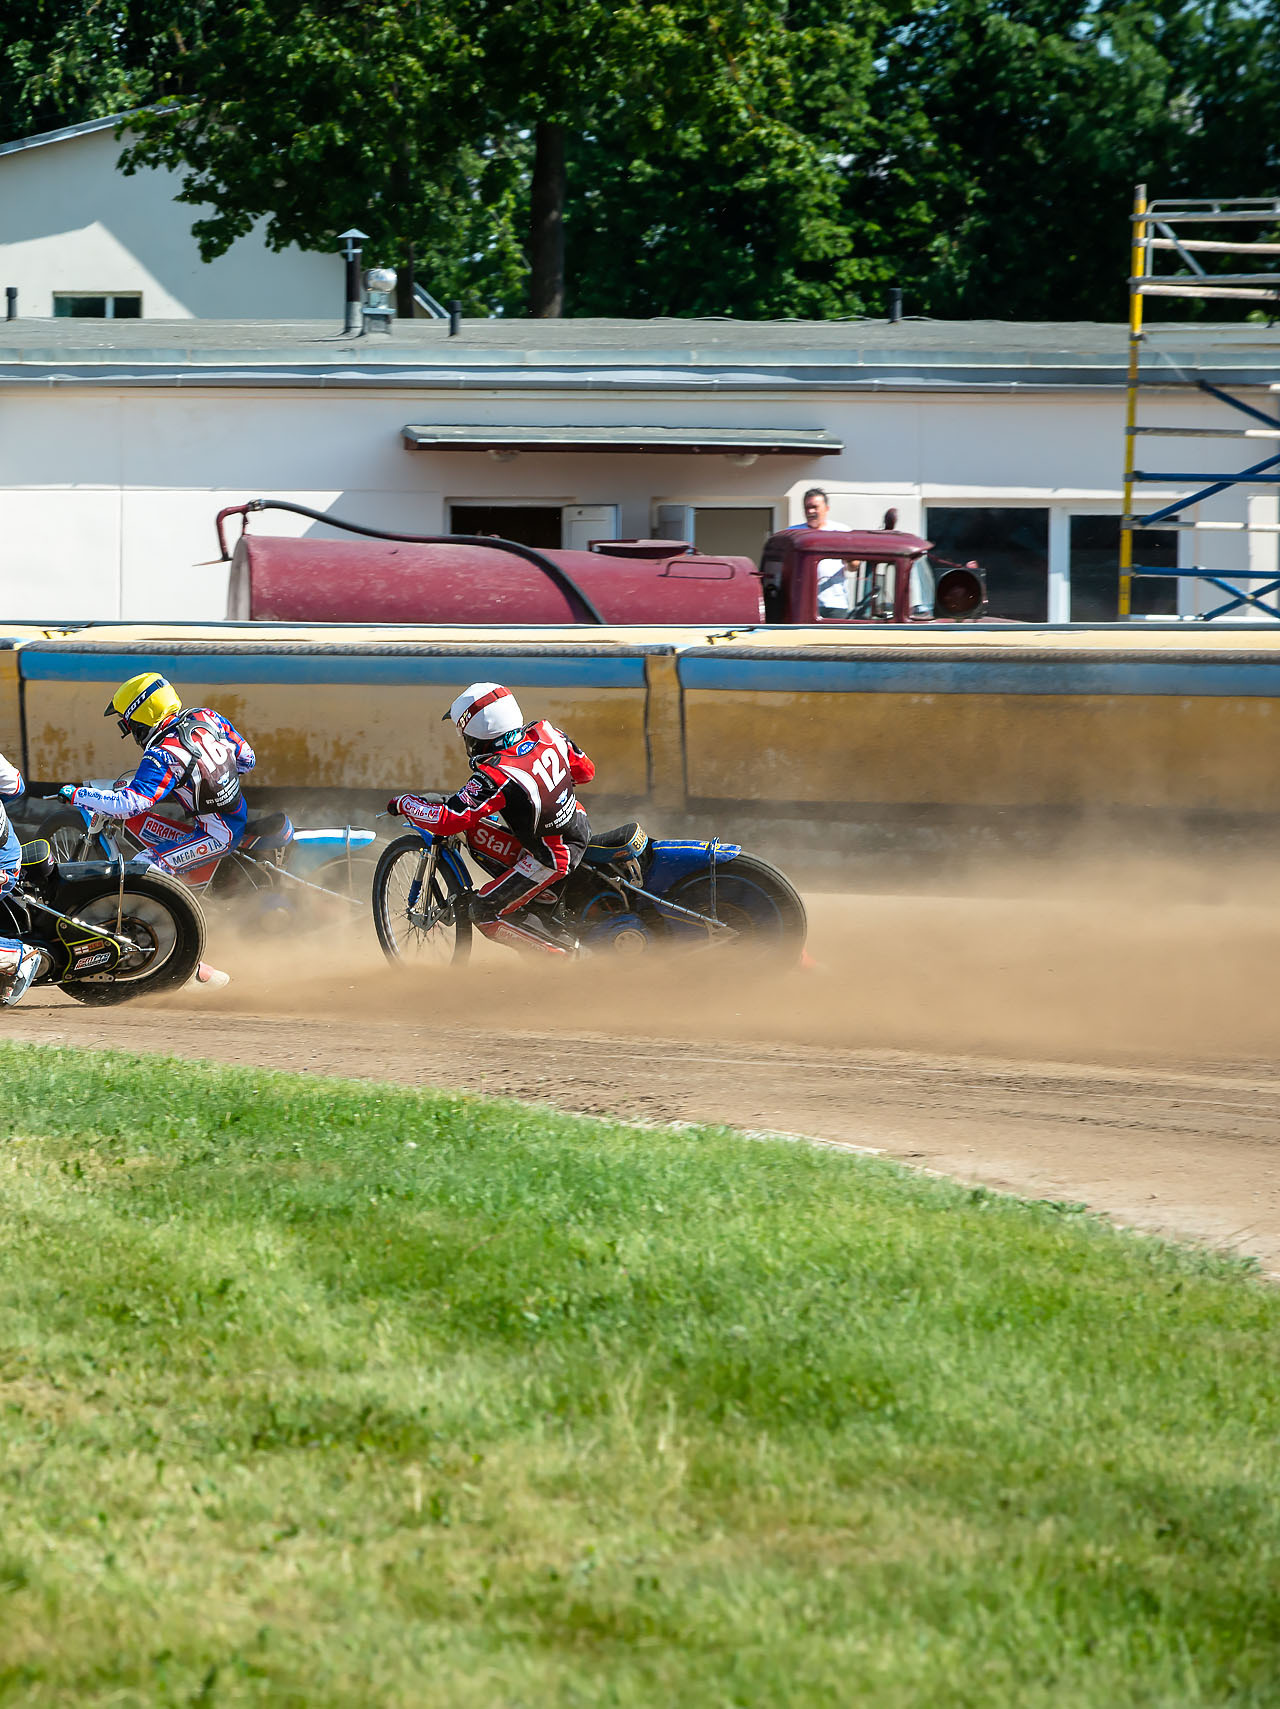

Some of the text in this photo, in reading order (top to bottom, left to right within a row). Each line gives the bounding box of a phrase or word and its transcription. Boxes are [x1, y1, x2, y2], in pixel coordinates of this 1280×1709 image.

[124, 691, 147, 719] SCOTT
[531, 747, 567, 793] 12
[172, 839, 223, 866] MEGA LA
